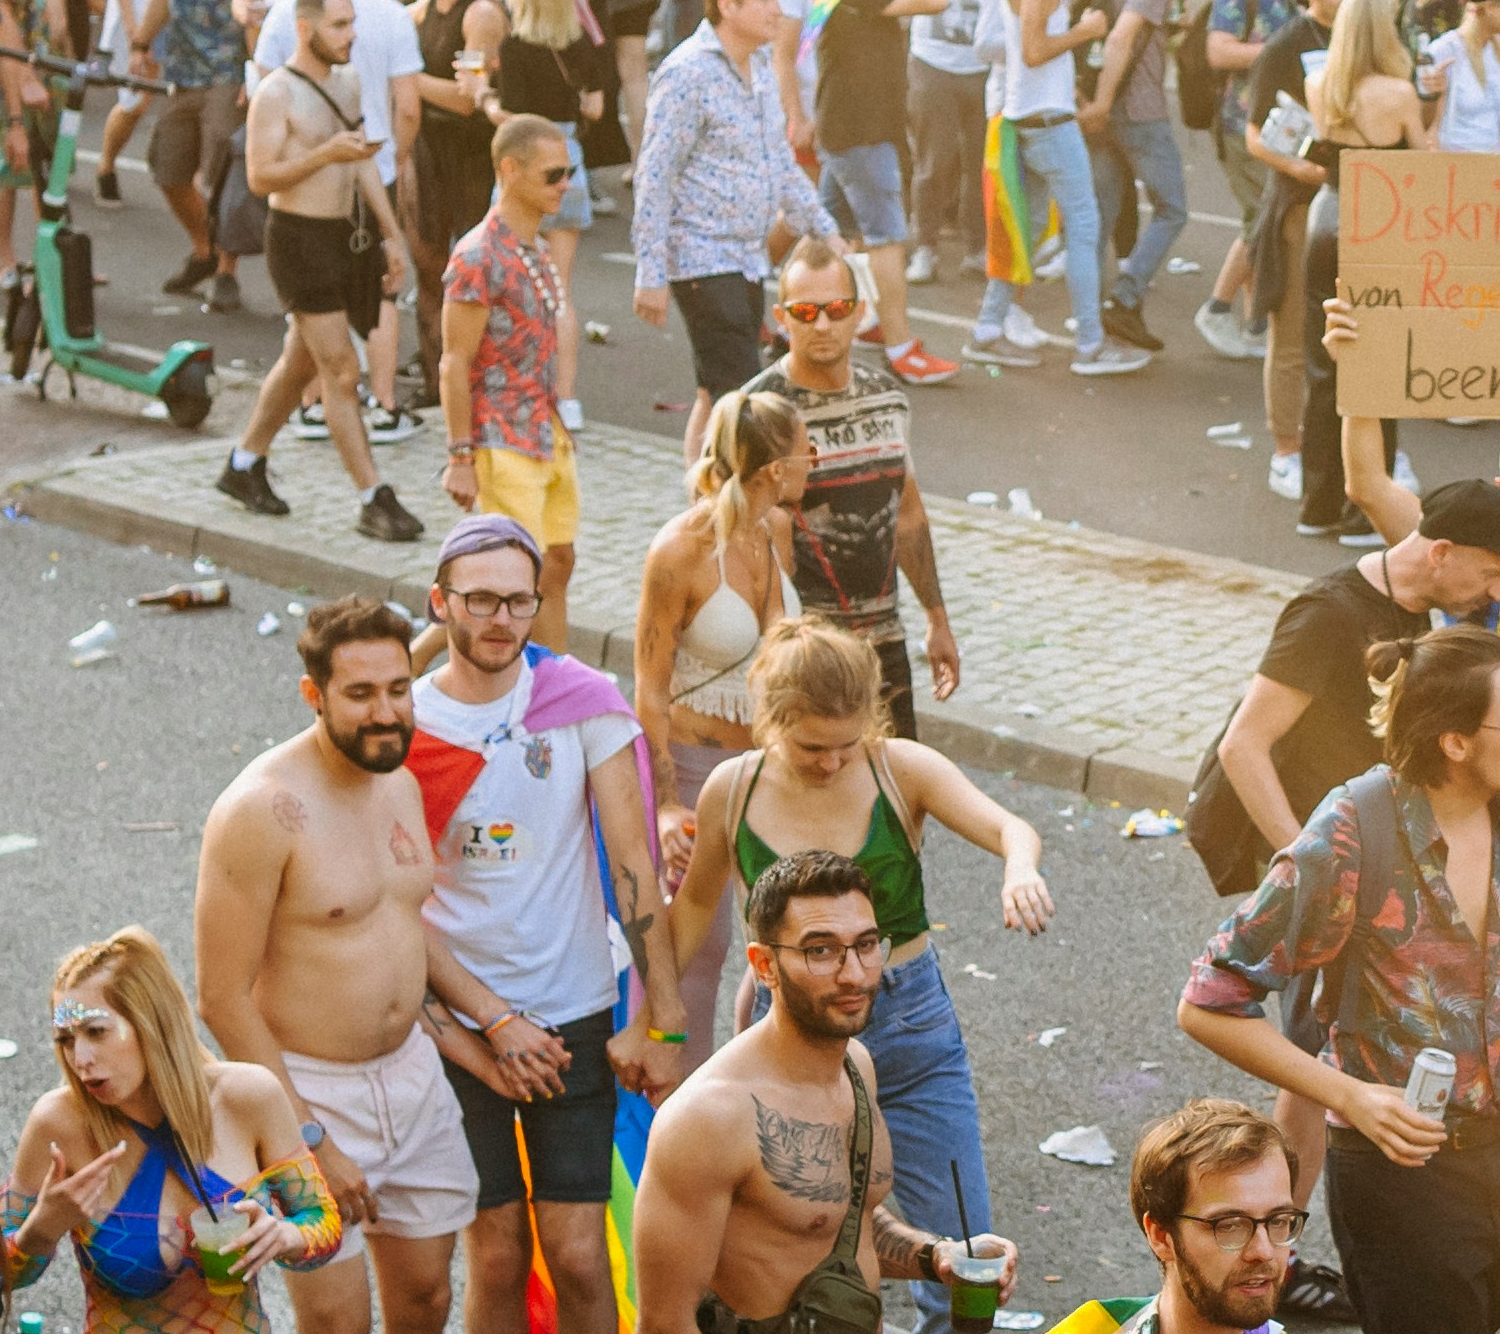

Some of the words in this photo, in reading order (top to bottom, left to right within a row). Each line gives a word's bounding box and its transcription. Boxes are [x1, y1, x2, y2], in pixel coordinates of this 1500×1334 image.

[1348, 285, 1403, 309] von
[470, 825, 483, 844] I
[850, 1149, 868, 1208] MAX
